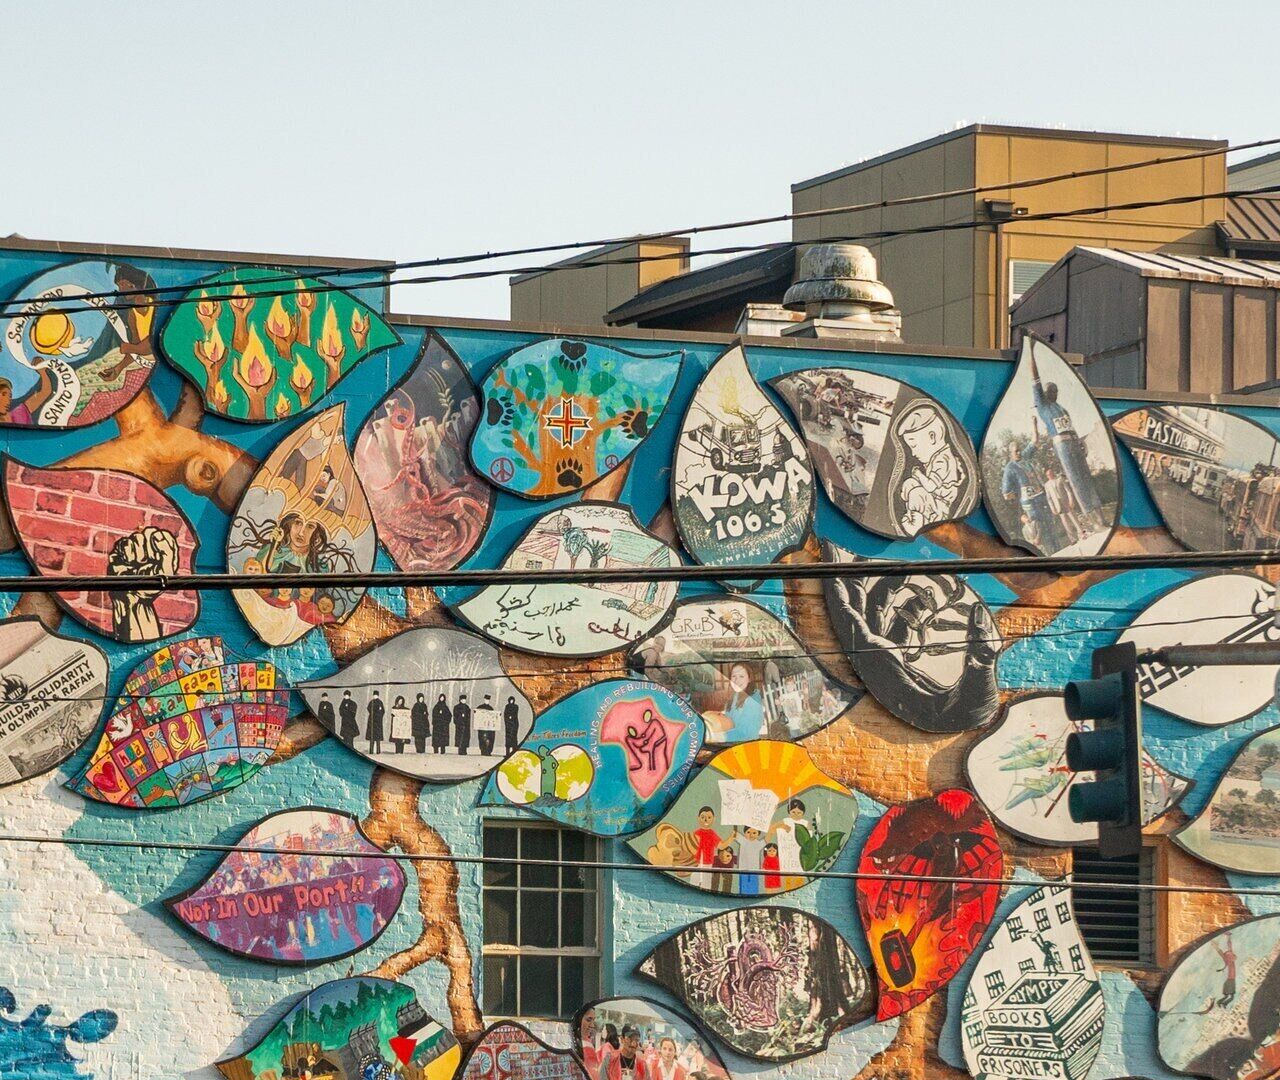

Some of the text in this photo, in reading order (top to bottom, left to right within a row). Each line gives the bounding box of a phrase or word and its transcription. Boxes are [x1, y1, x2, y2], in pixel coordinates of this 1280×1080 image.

[45, 357, 75, 425] SANTO TOMAS
[688, 457, 812, 522] KOWA
[715, 503, 786, 541] 106.5
[31, 660, 91, 704] SOLIDARITY
[8, 702, 51, 732] OLYMPIA
[62, 671, 95, 697] RAFAH
[590, 683, 699, 792] HEALING AND REBUILDING OUR COMMUNITIES
[178, 902, 212, 923] Not
[216, 897, 239, 919] In
[243, 891, 284, 917] Our
[1009, 980, 1063, 1003] OLYMPIA
[988, 1011, 1042, 1026] BOOKS
[1006, 1034, 1033, 1048] TO
[981, 1057, 1061, 1078] PRISONERS
